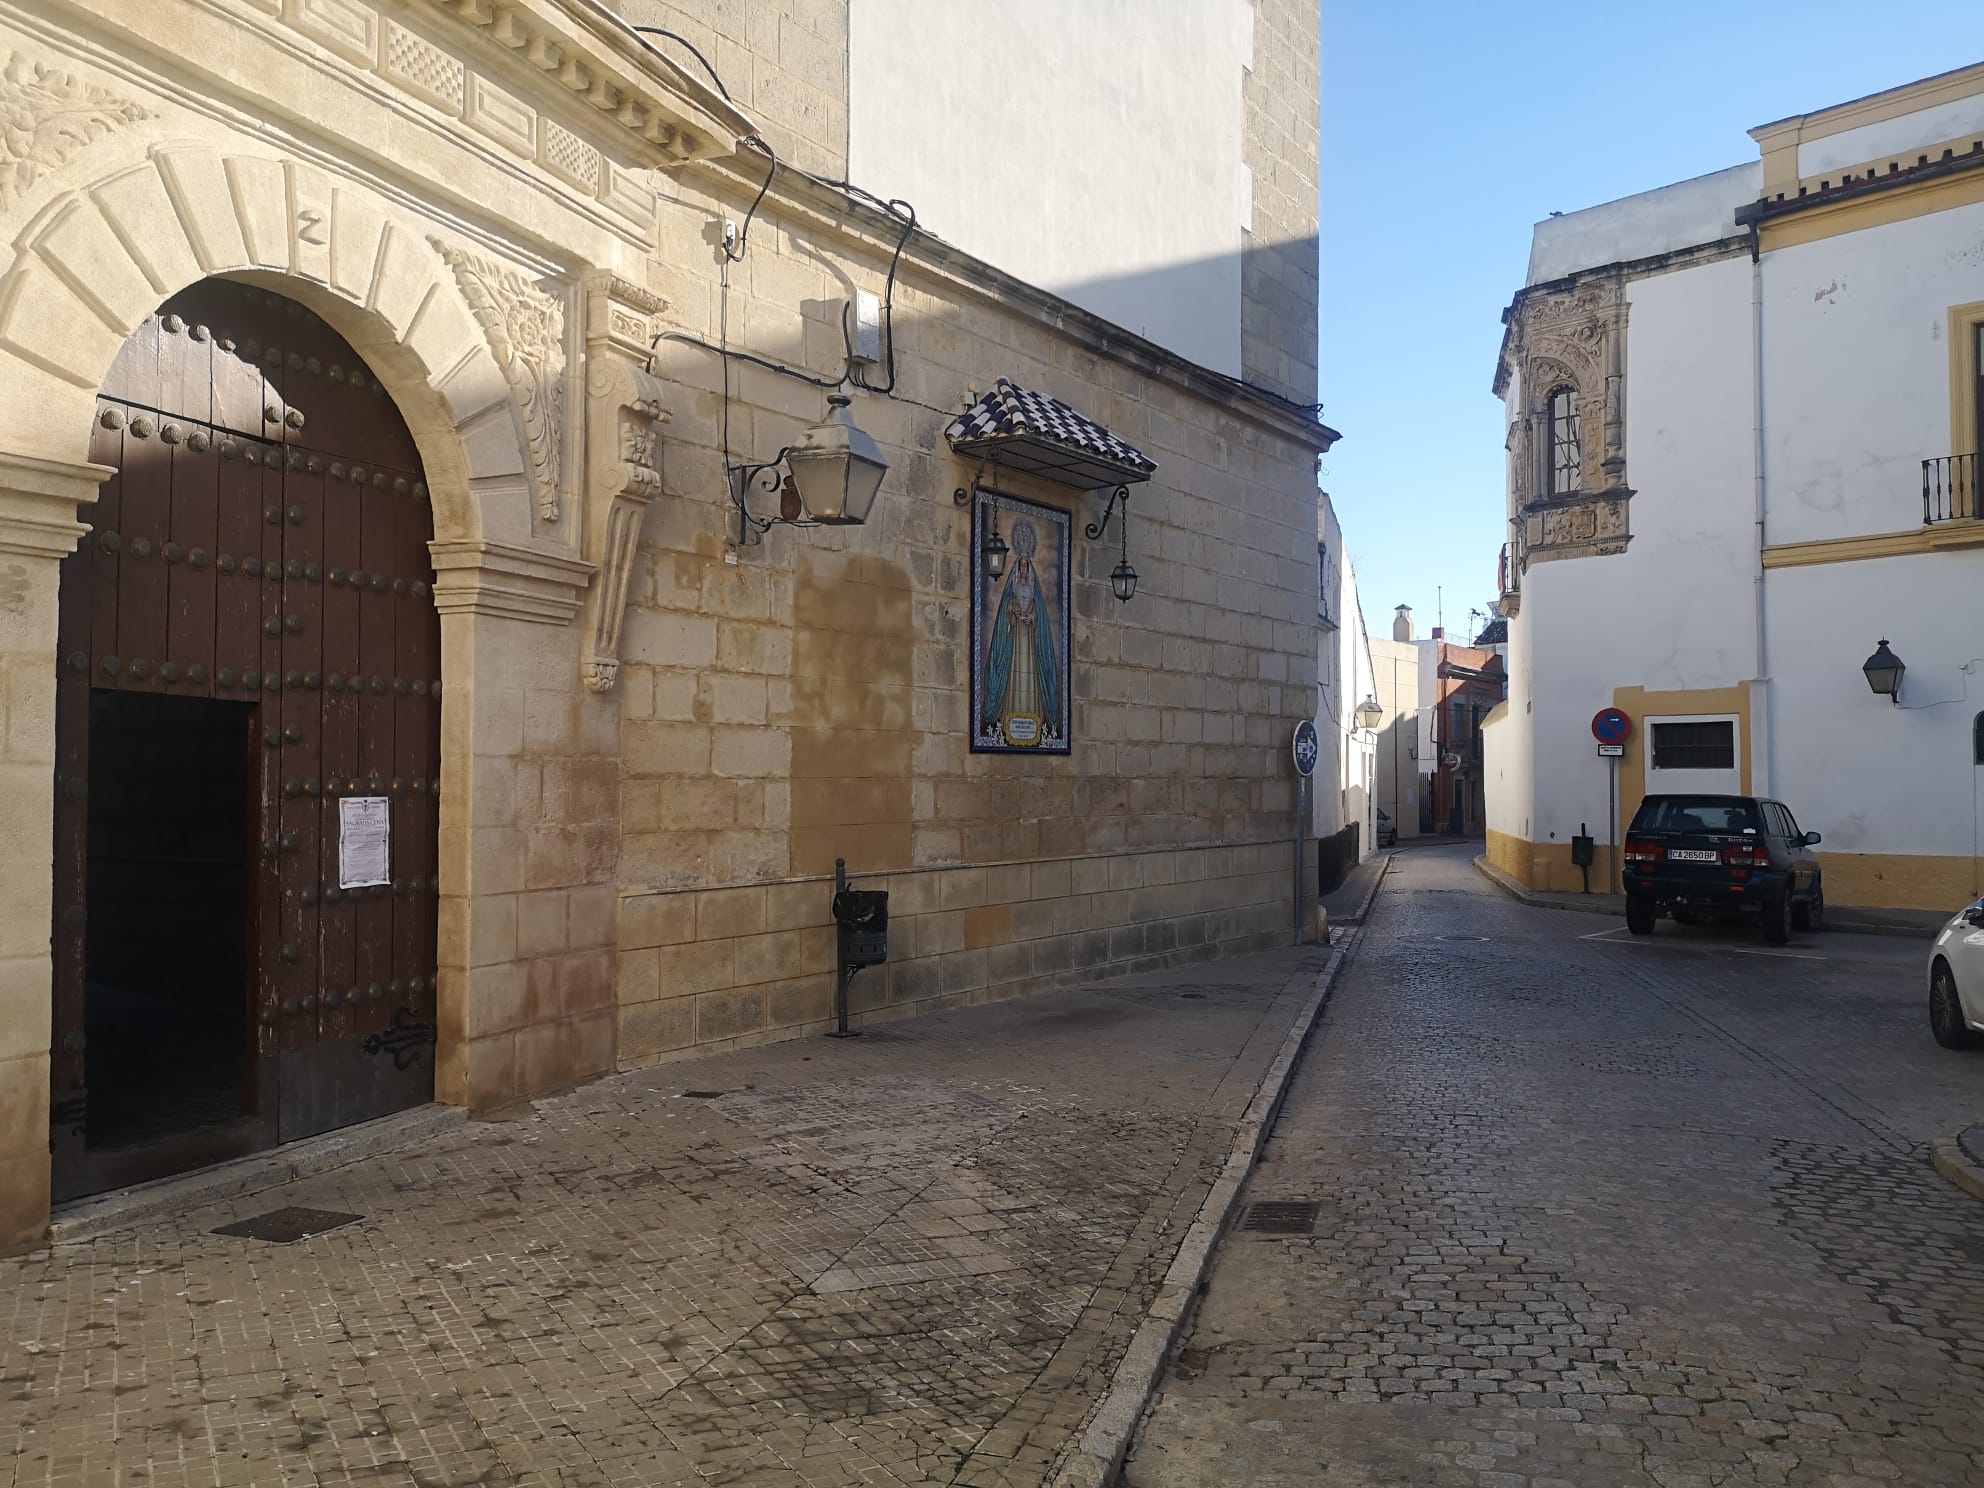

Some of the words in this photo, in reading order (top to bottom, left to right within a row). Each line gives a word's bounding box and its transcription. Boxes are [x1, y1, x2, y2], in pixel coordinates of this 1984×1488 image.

[1672, 850, 1683, 858] CA
[1683, 851, 1704, 859] 2650
[1704, 852, 1715, 860] BP
